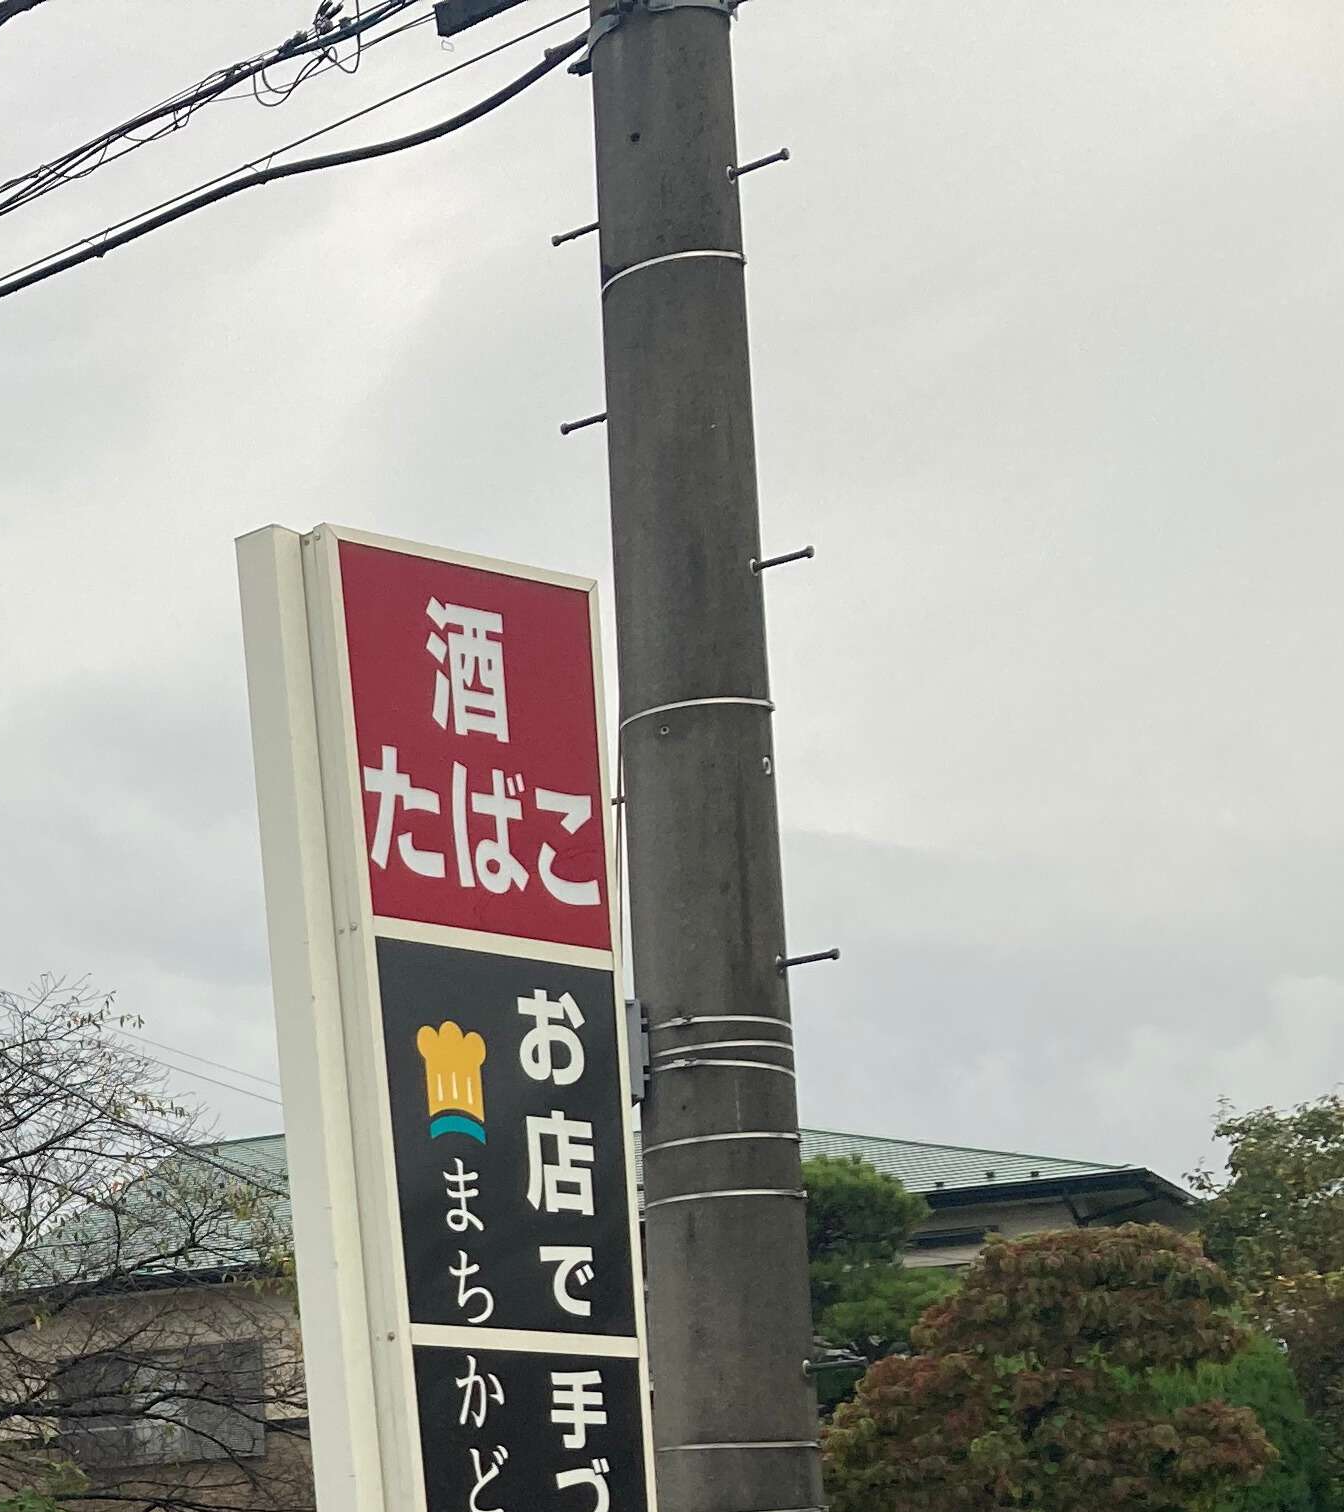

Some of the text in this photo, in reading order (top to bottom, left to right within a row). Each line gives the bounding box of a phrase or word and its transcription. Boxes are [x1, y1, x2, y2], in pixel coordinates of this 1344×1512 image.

[425, 596, 510, 744] 酒
[363, 744, 602, 907] たばこ
